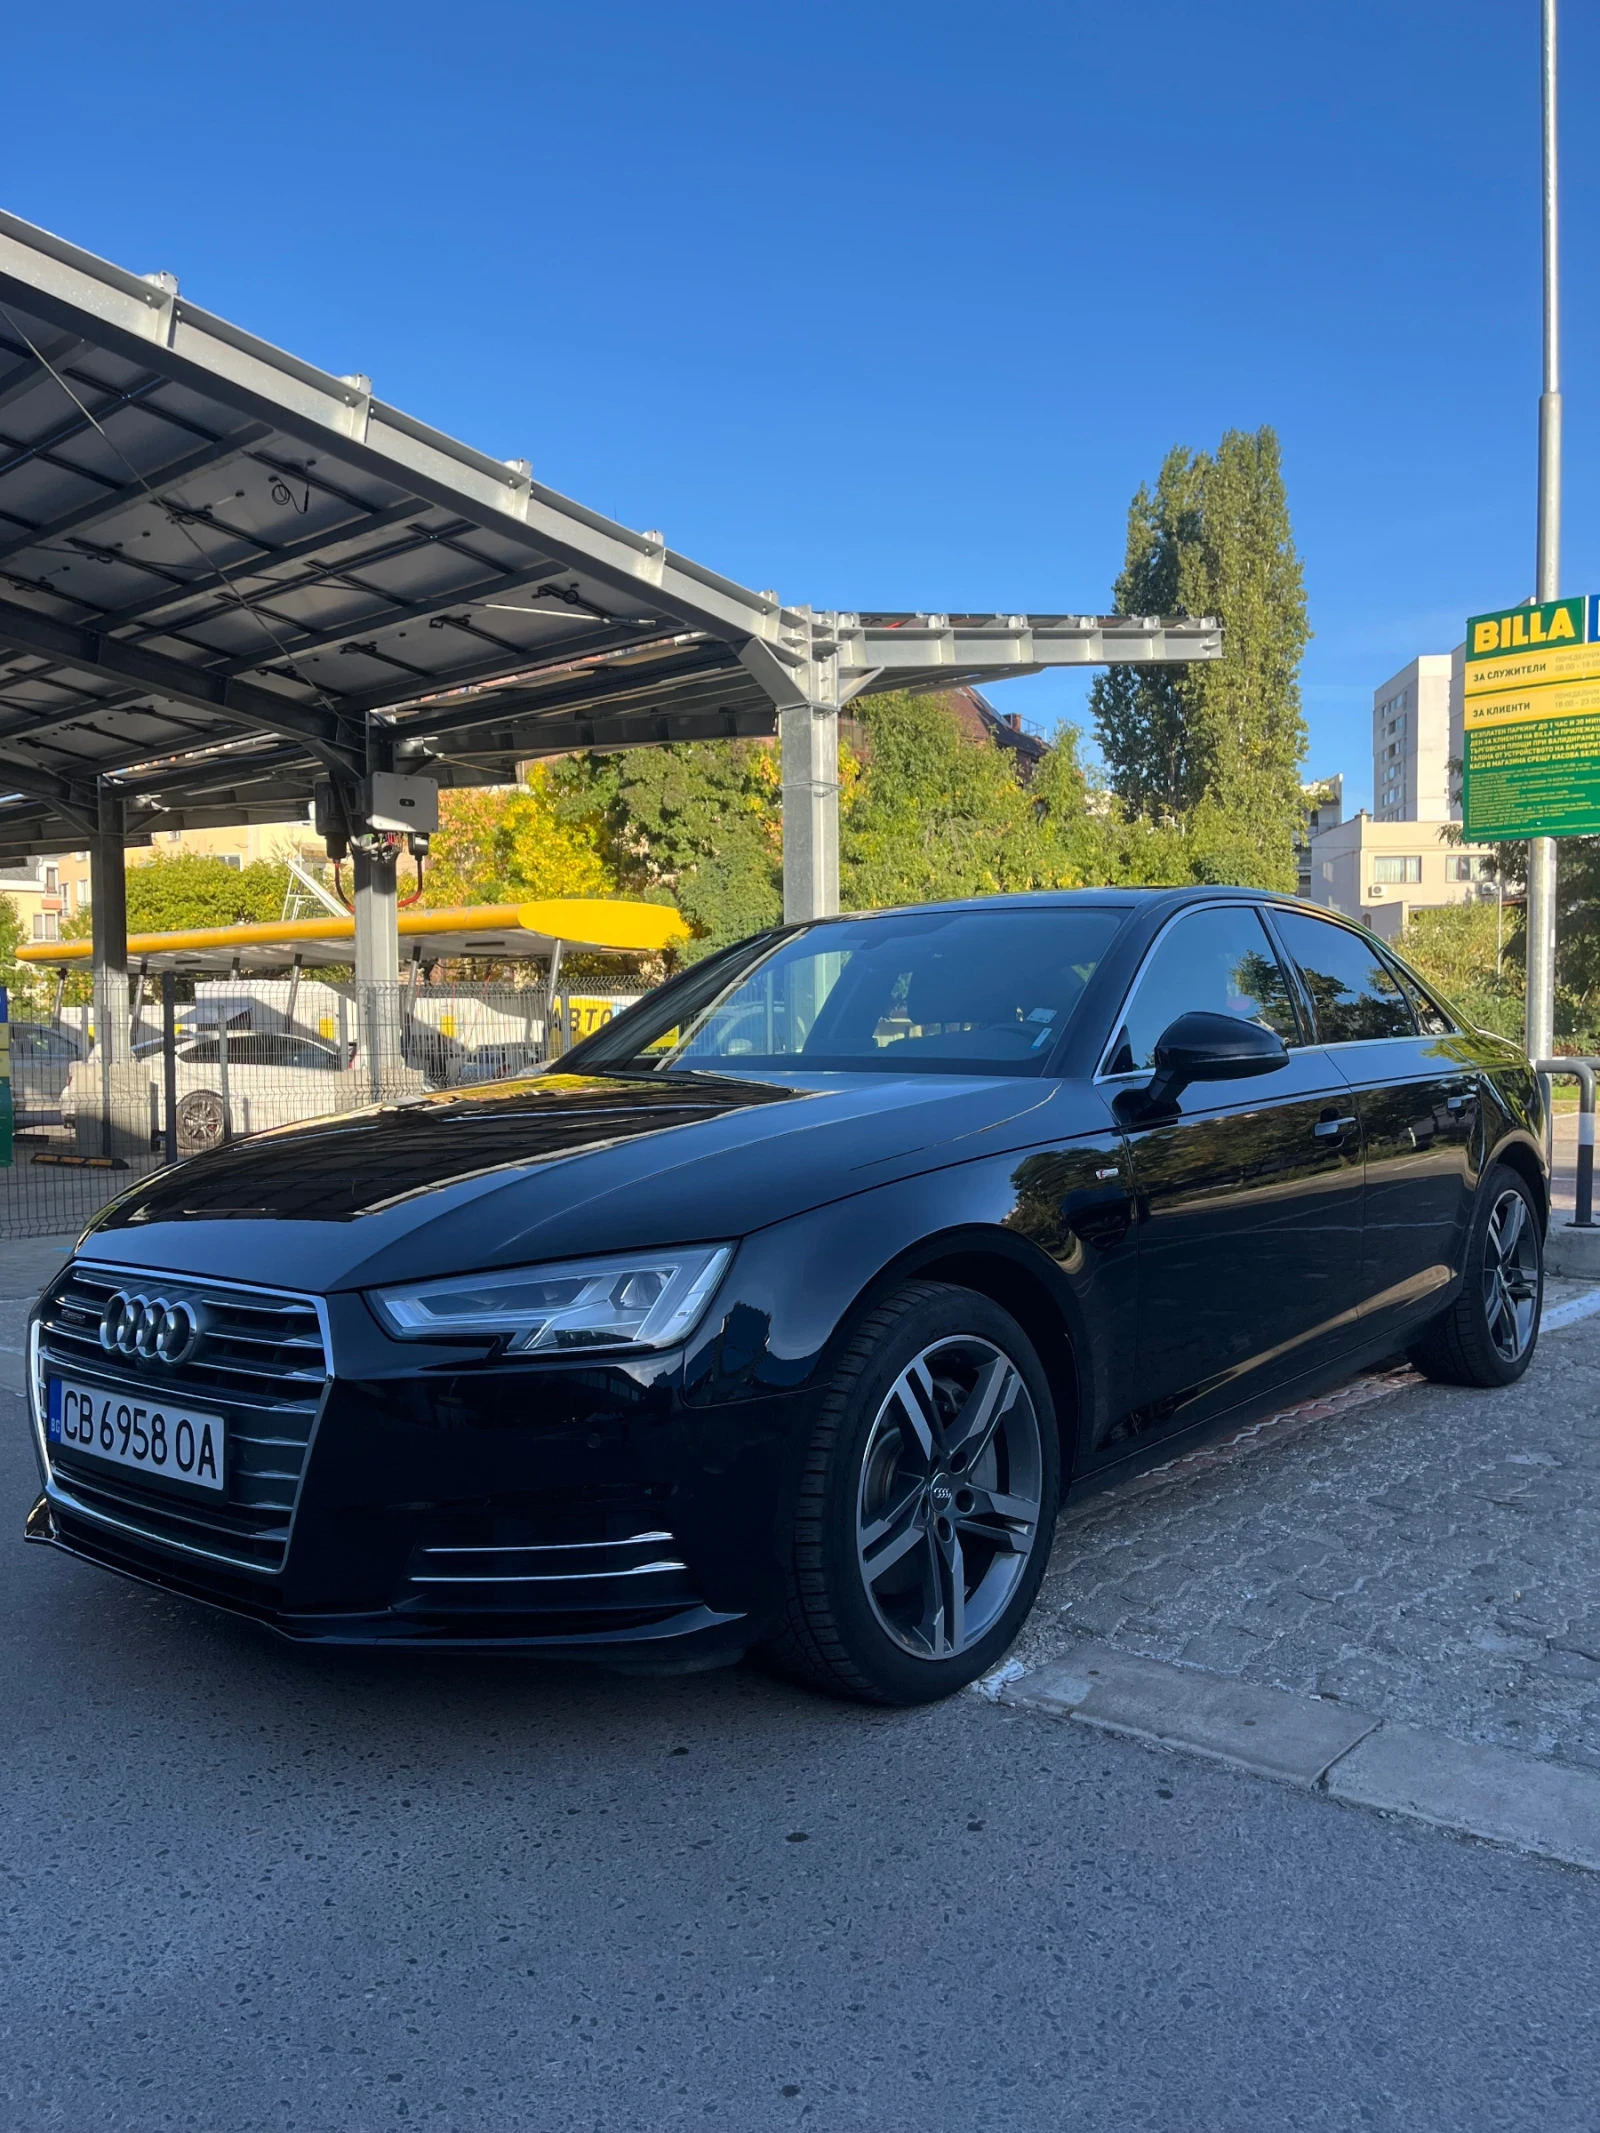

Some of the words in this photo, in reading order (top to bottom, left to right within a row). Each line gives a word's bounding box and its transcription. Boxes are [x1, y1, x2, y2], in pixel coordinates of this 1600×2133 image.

[1474, 607, 1575, 653] BILLA
[1473, 674, 1485, 682] ЗА
[1487, 663, 1546, 680] СЛУЖИТЕЛИ
[1473, 709, 1484, 718] ЗА
[1486, 702, 1530, 716] КЛИЕНТИ
[1507, 723, 1537, 733] ПАРКИНГ
[1538, 722, 1548, 731] ДО
[1554, 720, 1568, 728] ЧАС
[1470, 744, 1506, 755] ТЪРГОВСКИ
[1533, 739, 1547, 747] ПРИ
[1548, 733, 1595, 745] ВАЛИДИРАНЕ
[1493, 734, 1522, 744] КЛИЕНТИ
[1524, 732, 1533, 740] НА
[1534, 730, 1553, 738] BILLA
[1470, 753, 1494, 762] ТАЛОНА
[1495, 751, 1503, 759] ОТ
[1555, 744, 1565, 752] НА
[1470, 762, 1486, 770] КАСА
[1492, 757, 1526, 767] МАГАЗИНА
[1527, 753, 1551, 763] СРЕЩУ
[1552, 751, 1579, 761] КАСОВА
[50, 1417, 61, 1434] BG
[64, 1390, 93, 1445] CB
[100, 1400, 168, 1466] 6958
[175, 1418, 217, 1480] OA
